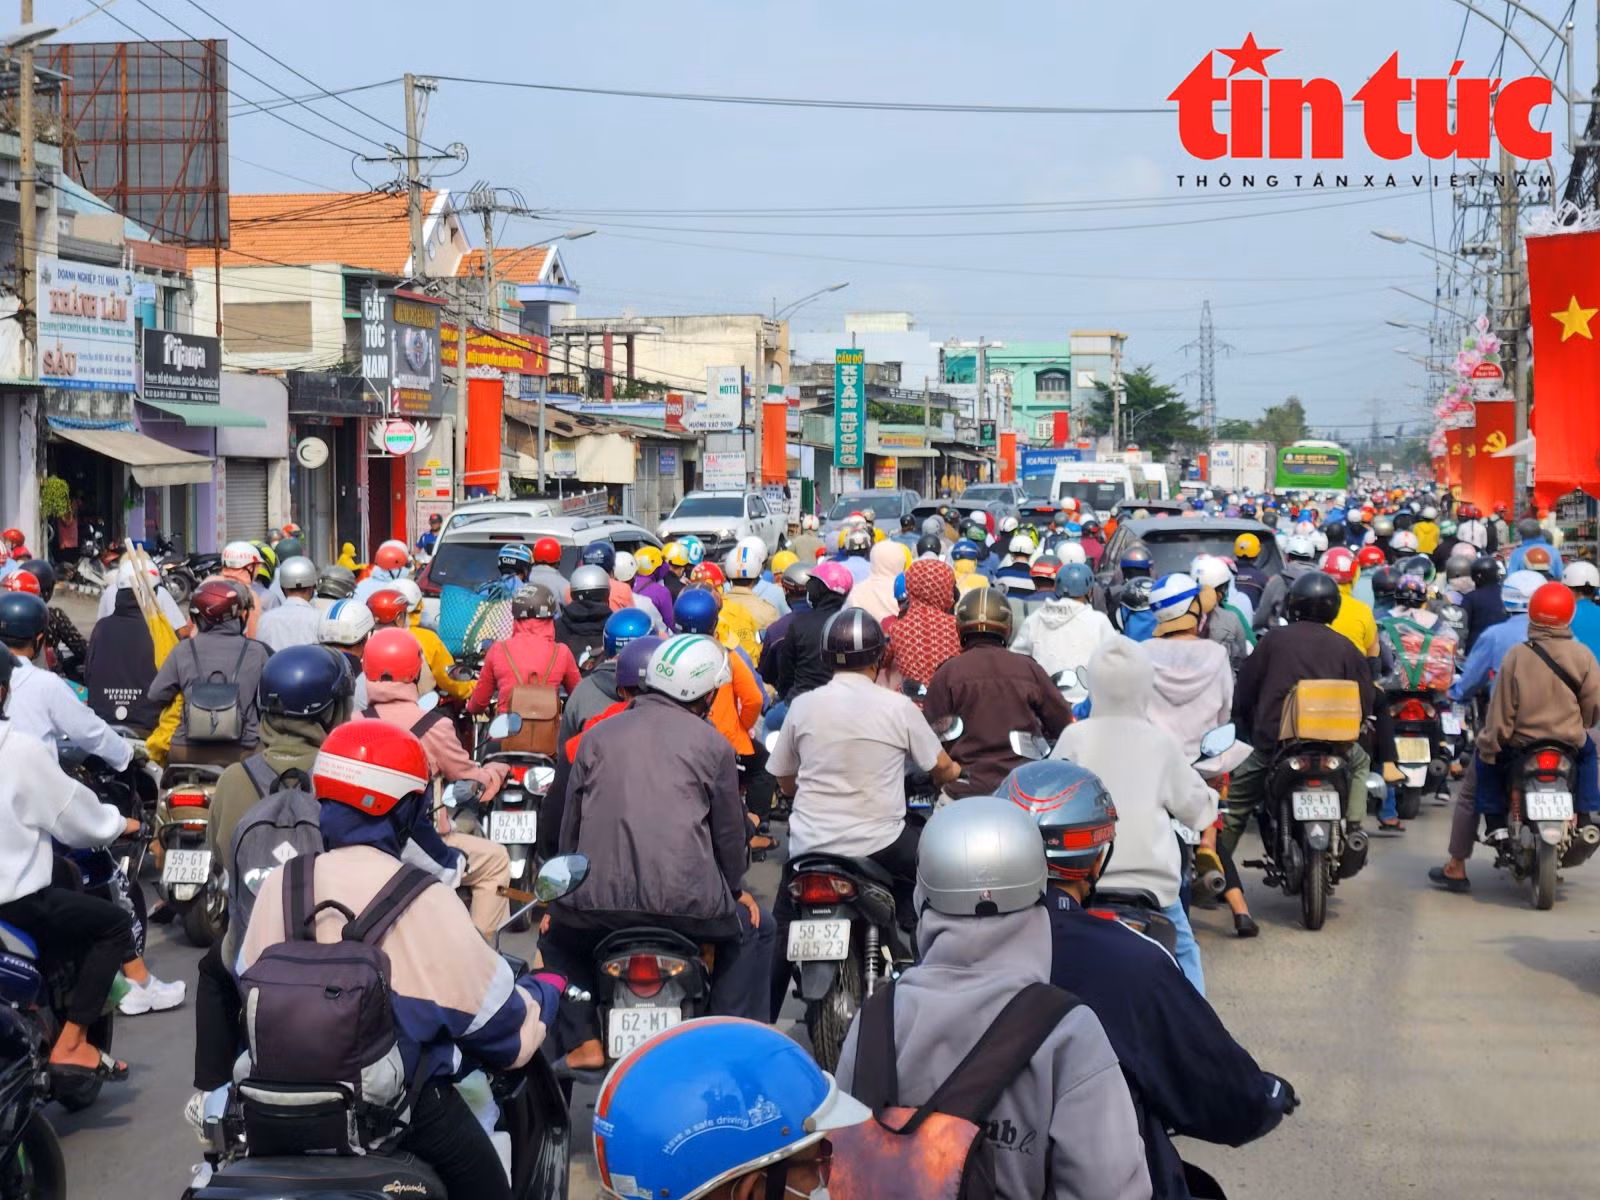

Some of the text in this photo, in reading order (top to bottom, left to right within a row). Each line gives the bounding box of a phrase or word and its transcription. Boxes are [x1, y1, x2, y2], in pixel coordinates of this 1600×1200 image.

[364, 321, 386, 348] TÓC
[362, 355, 388, 379] NAM
[719, 385, 740, 395] HOTEL
[799, 923, 841, 939] 59-S2
[662, 1115, 749, 1154] Have a safe driving
